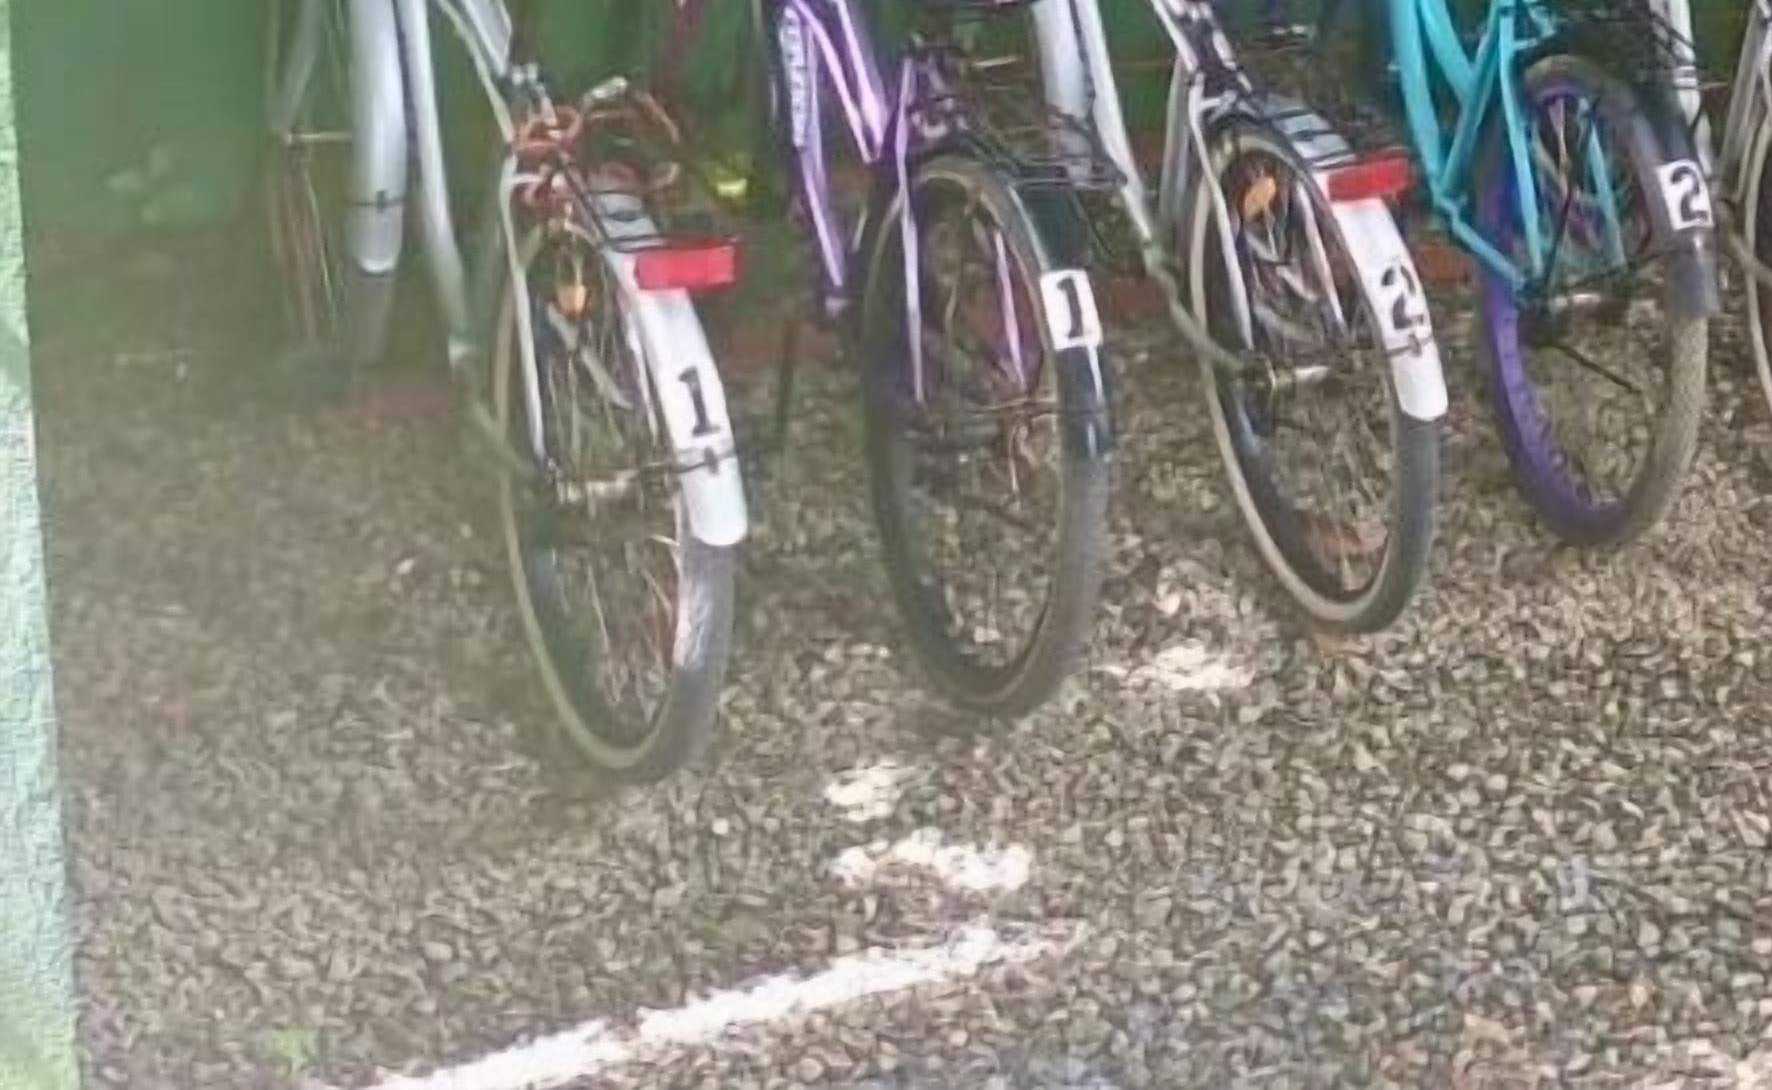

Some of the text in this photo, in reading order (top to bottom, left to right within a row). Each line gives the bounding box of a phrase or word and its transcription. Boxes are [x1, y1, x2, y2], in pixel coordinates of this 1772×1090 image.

[1670, 165, 1709, 223] 2
[1056, 274, 1084, 340] 1
[1380, 264, 1425, 330] 2
[678, 365, 721, 437] 1
